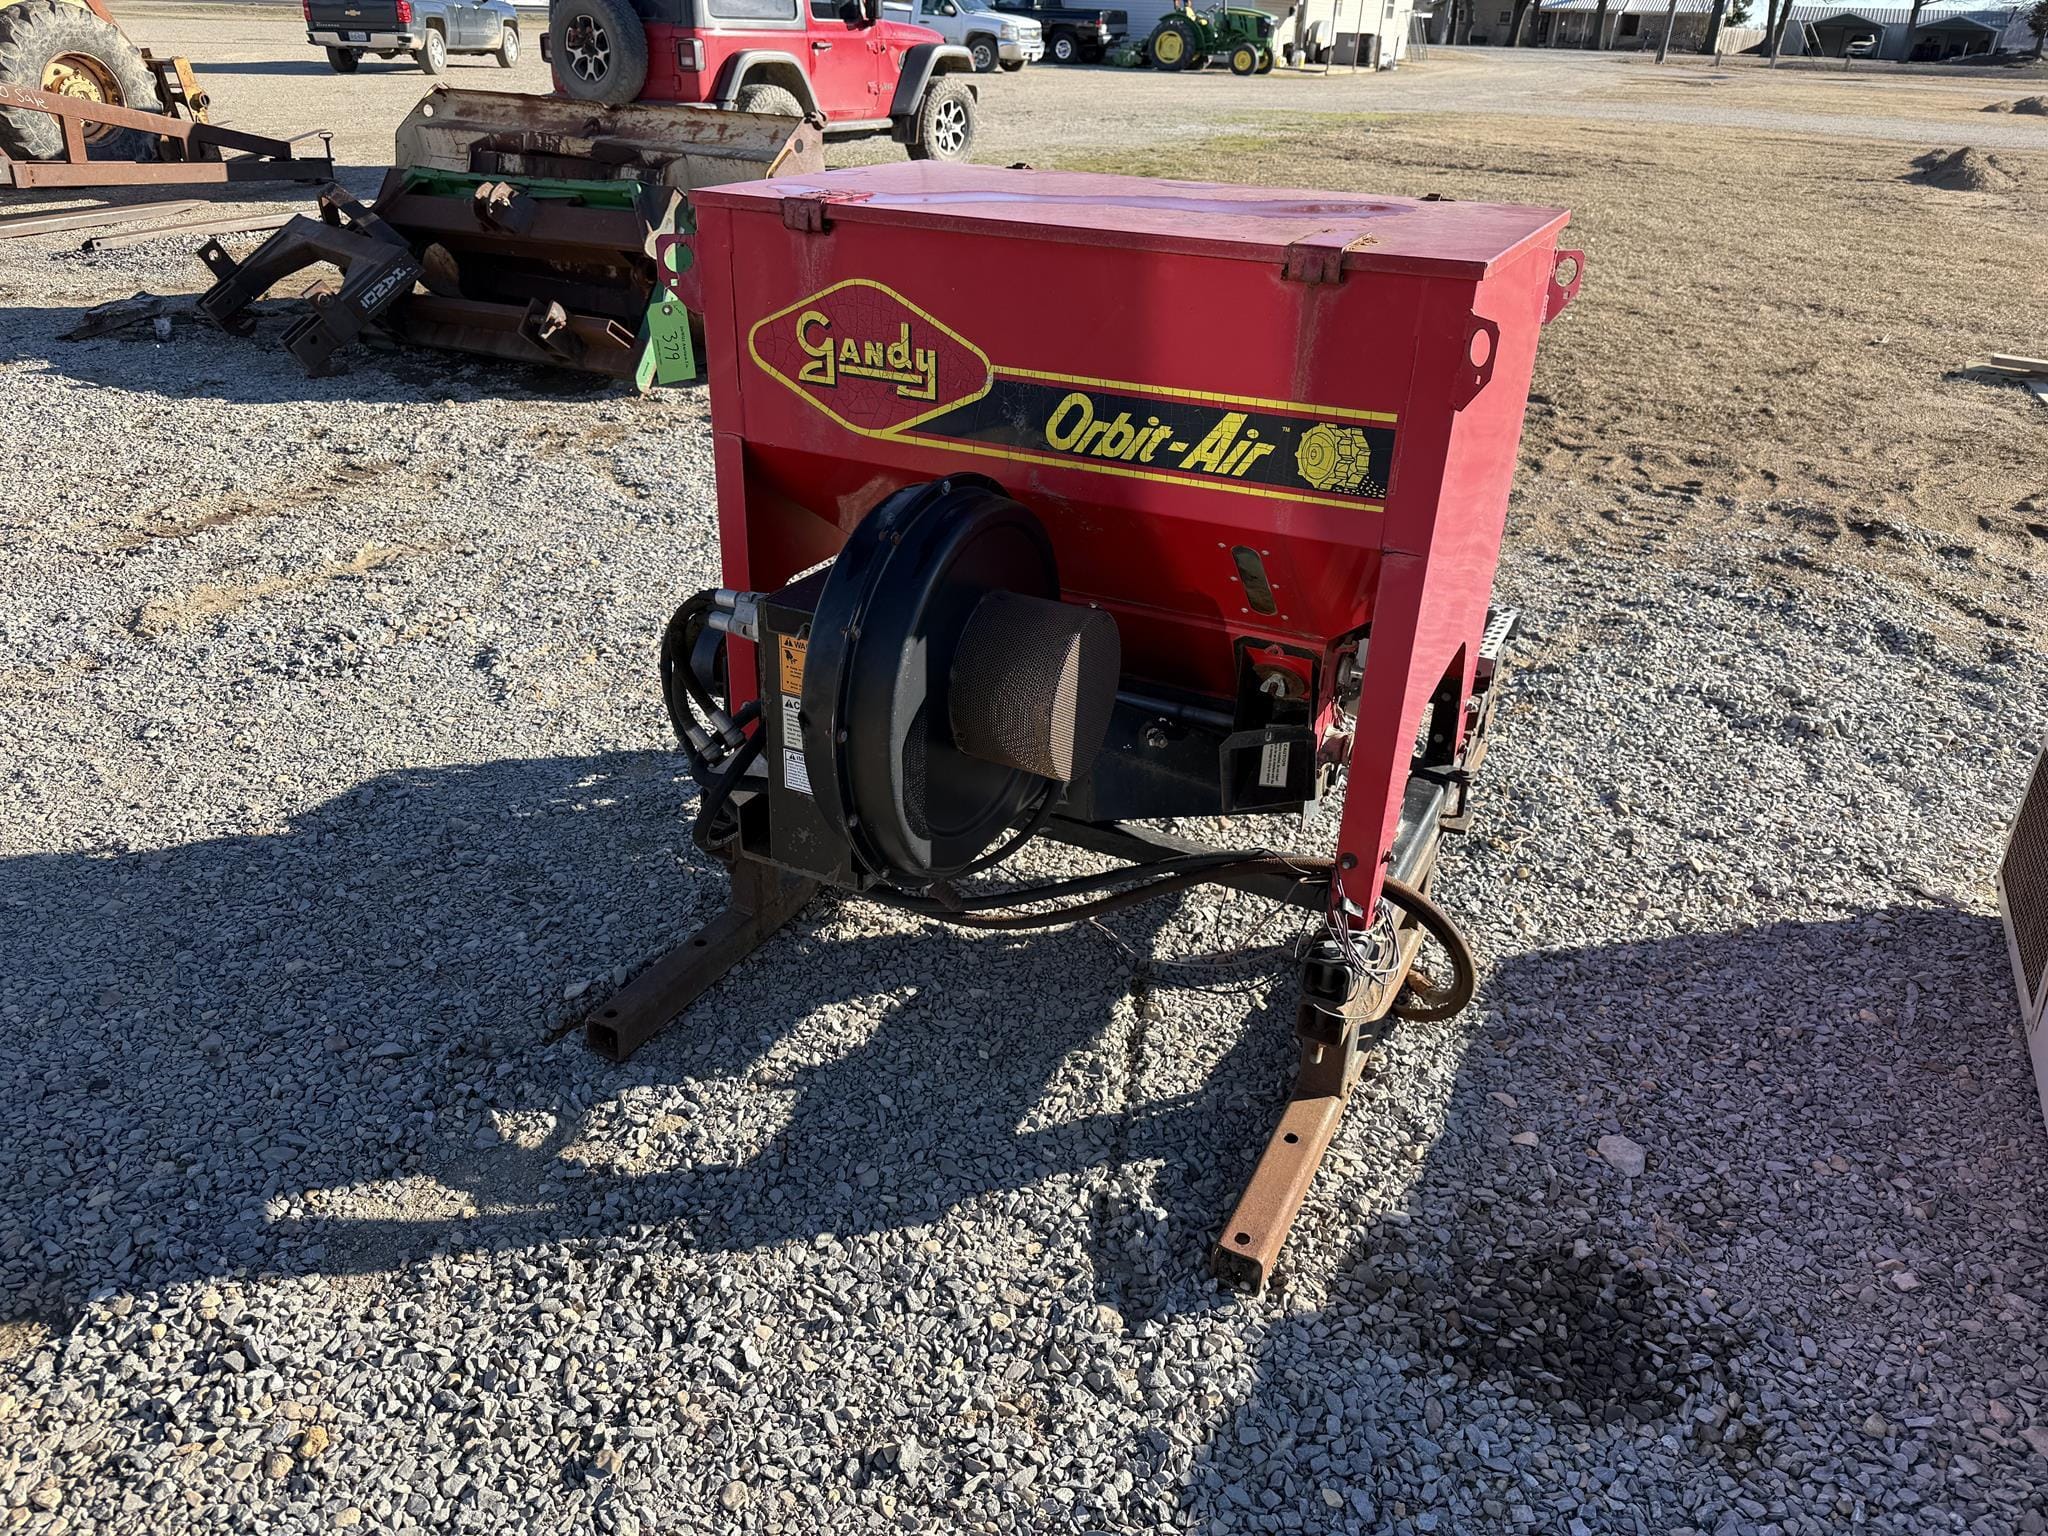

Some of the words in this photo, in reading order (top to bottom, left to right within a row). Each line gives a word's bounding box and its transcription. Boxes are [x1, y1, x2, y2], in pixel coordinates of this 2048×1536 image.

[15, 89, 49, 109] Sale
[662, 330, 680, 360] 379
[1045, 392, 1277, 477] Orbit-Air
